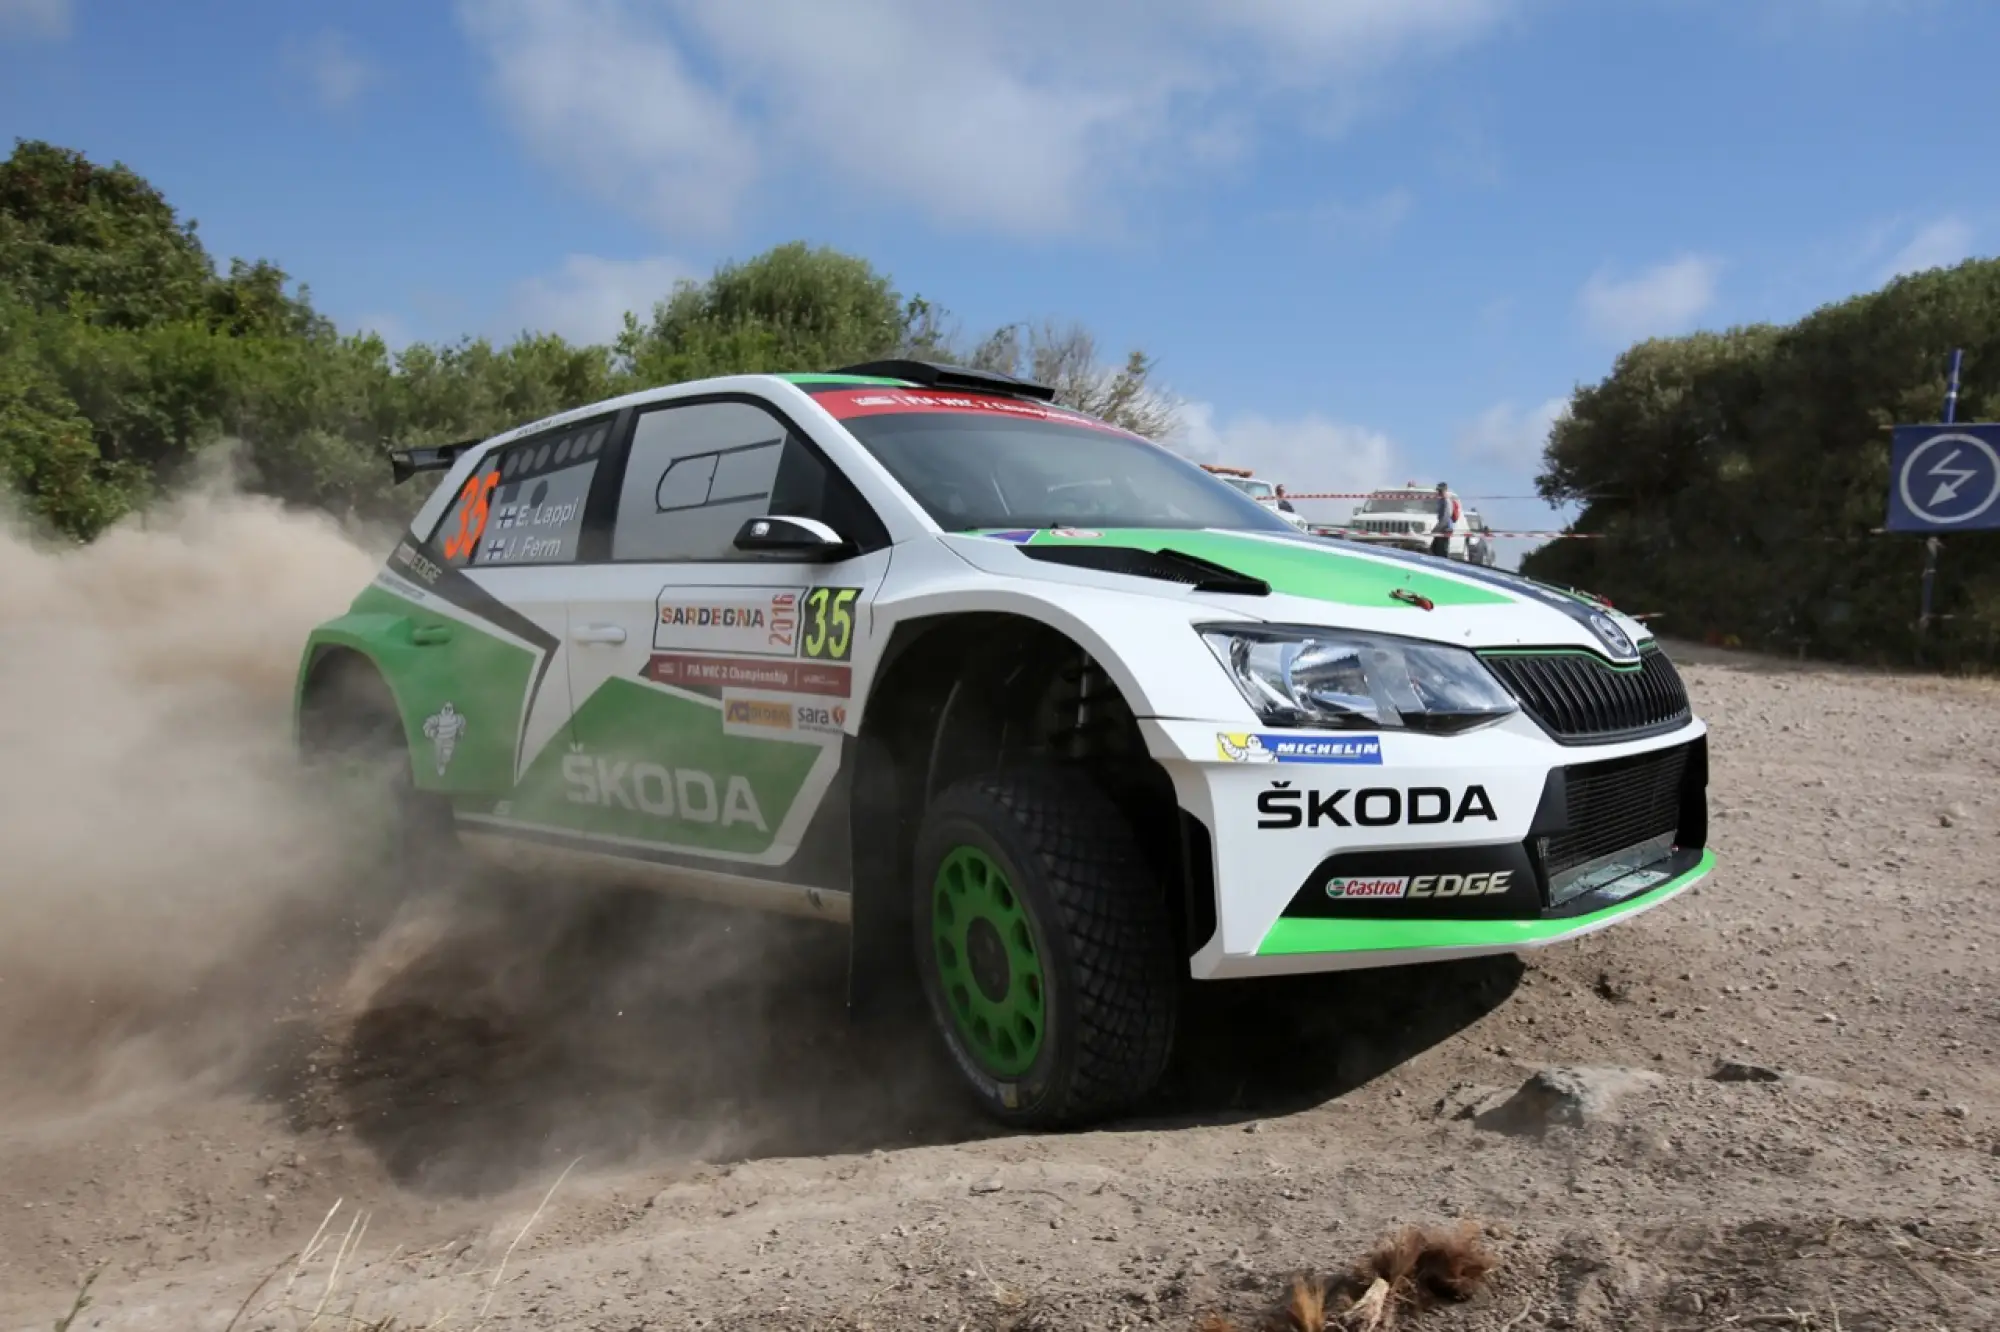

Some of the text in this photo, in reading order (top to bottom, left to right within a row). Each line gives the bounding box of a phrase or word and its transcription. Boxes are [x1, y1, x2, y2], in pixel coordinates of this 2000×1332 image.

[516, 496, 579, 528] E. Lappi
[521, 536, 561, 557] Ferm
[661, 606, 765, 629] SARDEGNA
[768, 593, 796, 646] 2016
[805, 587, 857, 658] 35
[729, 667, 788, 686] Championship
[797, 705, 829, 725] sara
[1276, 742, 1379, 755] MICHELIN
[562, 742, 770, 833] ŠKODA
[1257, 781, 1498, 830] ŠKODA
[1345, 870, 1515, 898] Castrol EDGE
